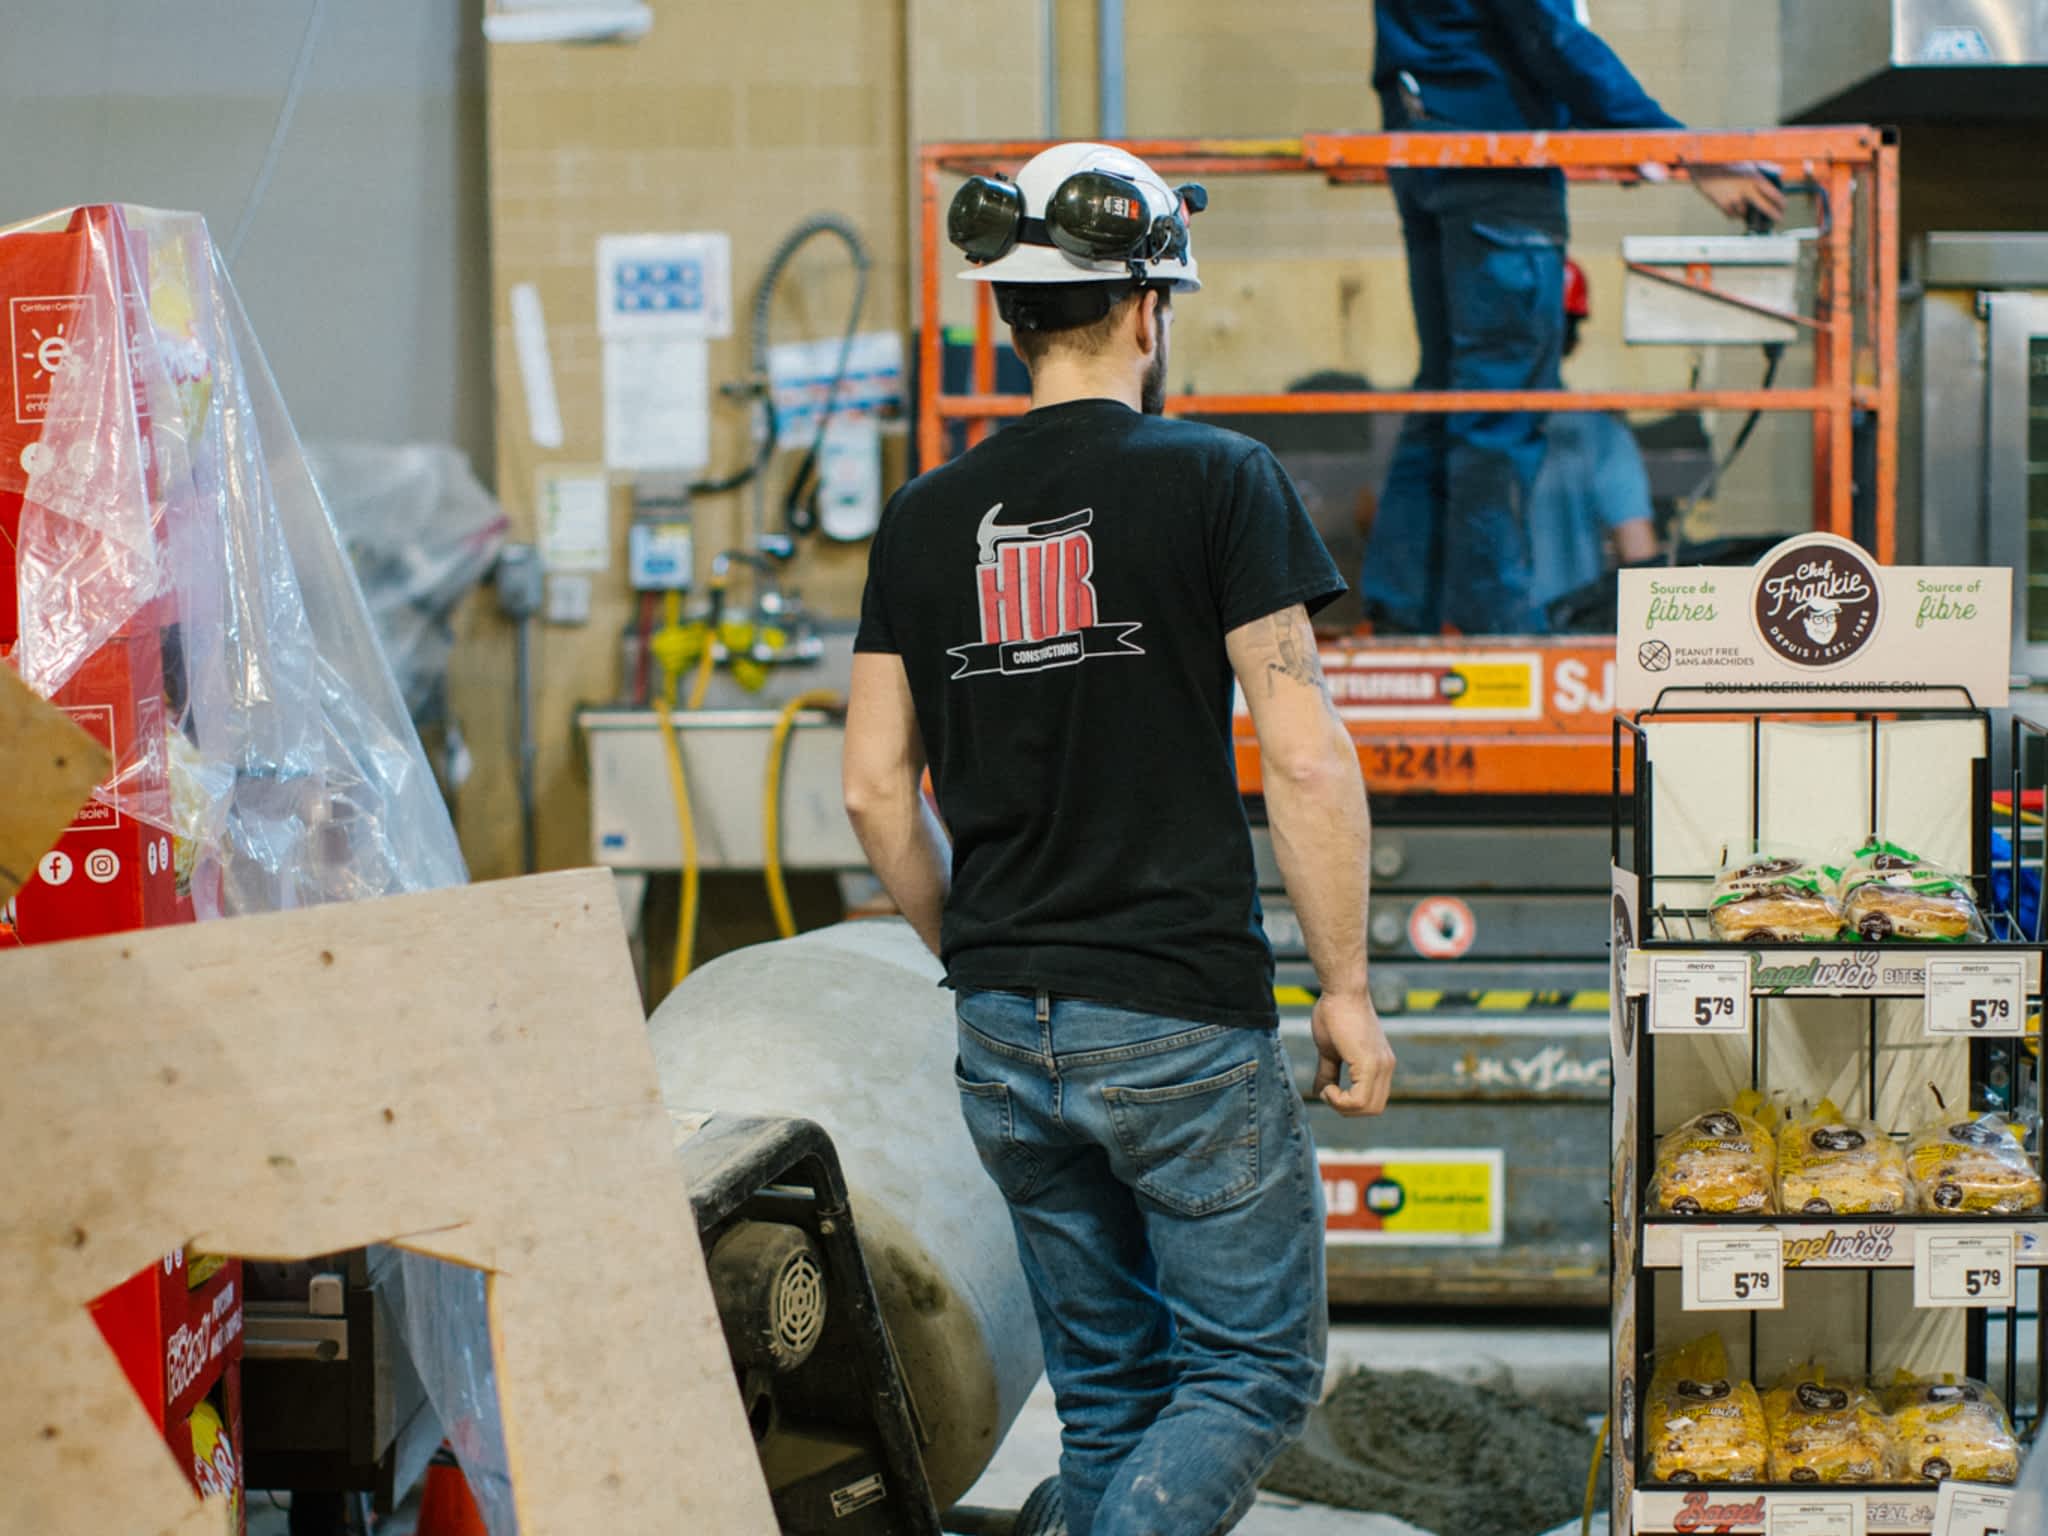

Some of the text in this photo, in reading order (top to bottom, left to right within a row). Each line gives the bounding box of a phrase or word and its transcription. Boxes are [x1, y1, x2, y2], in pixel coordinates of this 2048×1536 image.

[1796, 560, 1832, 580] Chef
[1917, 579, 1982, 593] Source of
[976, 530, 1098, 645] HUR
[1650, 580, 1716, 594] Source de
[1764, 571, 1870, 617] Frankie
[1646, 595, 1718, 630] fibres
[1915, 593, 1977, 629] fibre
[1675, 647, 1740, 657] PEANUT FREE
[1770, 626, 1809, 658] DEPUIS
[1824, 642, 1852, 657] EST.
[1675, 657, 1755, 667] SANS ARACHIDES
[1782, 1224, 1893, 1267] agelwich
